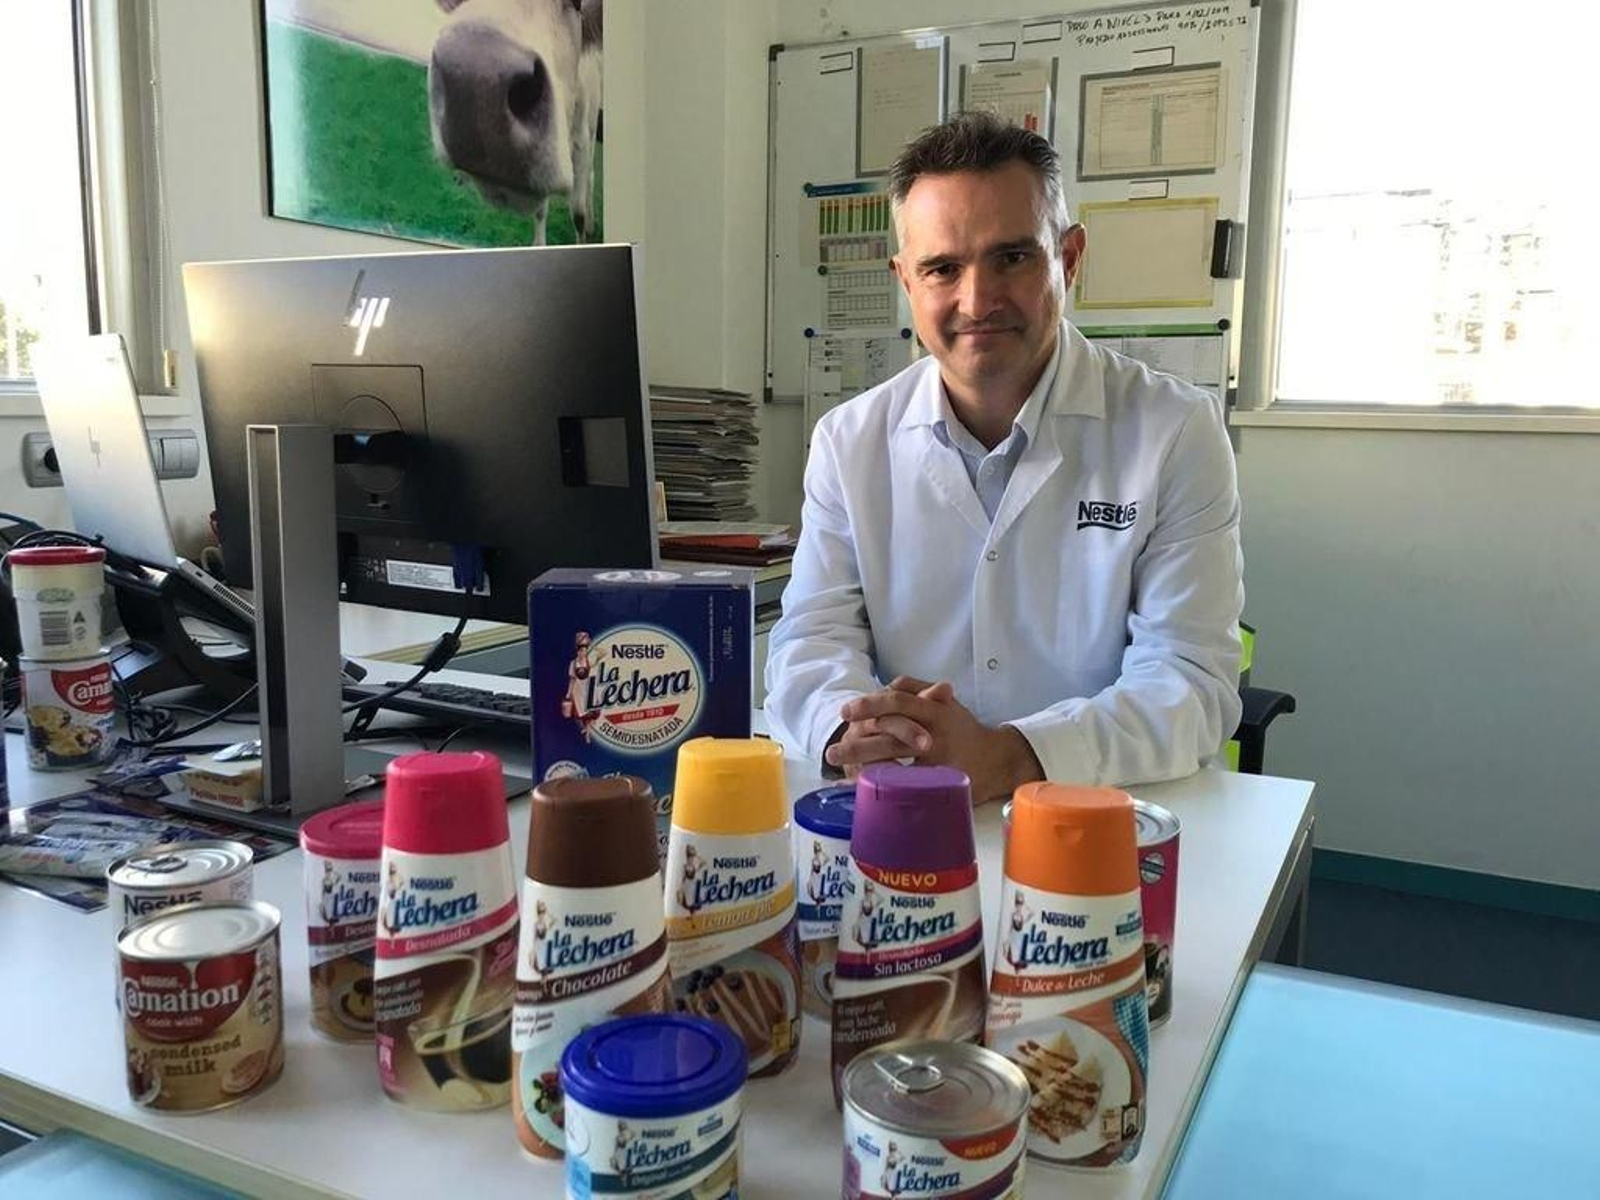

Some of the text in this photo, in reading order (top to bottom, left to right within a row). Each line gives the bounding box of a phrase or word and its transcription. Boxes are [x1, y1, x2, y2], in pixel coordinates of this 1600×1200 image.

[1078, 500, 1137, 526] Nestlé
[611, 644, 666, 660] Nestlé
[598, 661, 619, 684] La
[586, 668, 693, 710] Lechera
[599, 716, 684, 746] SEMIDESNATADA
[713, 856, 757, 869] Nestlé
[410, 877, 454, 890] Nestlé
[702, 869, 720, 887] La
[827, 865, 841, 882] La
[879, 871, 937, 888] NUEVO
[340, 884, 355, 901] La
[401, 890, 416, 908] La
[694, 870, 776, 908] Lechera
[394, 892, 478, 928] Lechera
[891, 896, 934, 908] Nestlé
[565, 912, 614, 927] Nestlé
[879, 908, 895, 924] La
[1041, 910, 1087, 929] Nestlé
[554, 929, 572, 949] La
[869, 910, 955, 947] Lechera
[1029, 923, 1047, 943] La
[546, 928, 635, 969] Lechera
[1020, 932, 1109, 968] Lechera
[874, 952, 942, 977] Sin lactosa
[551, 961, 632, 998] Chocolate
[1022, 979, 1052, 993] Dulce
[1067, 971, 1105, 989] Leche
[149, 1034, 242, 1060] condensed
[164, 1058, 216, 1077] milk
[625, 1139, 691, 1169] Lechera
[895, 1171, 961, 1195] Lechera
